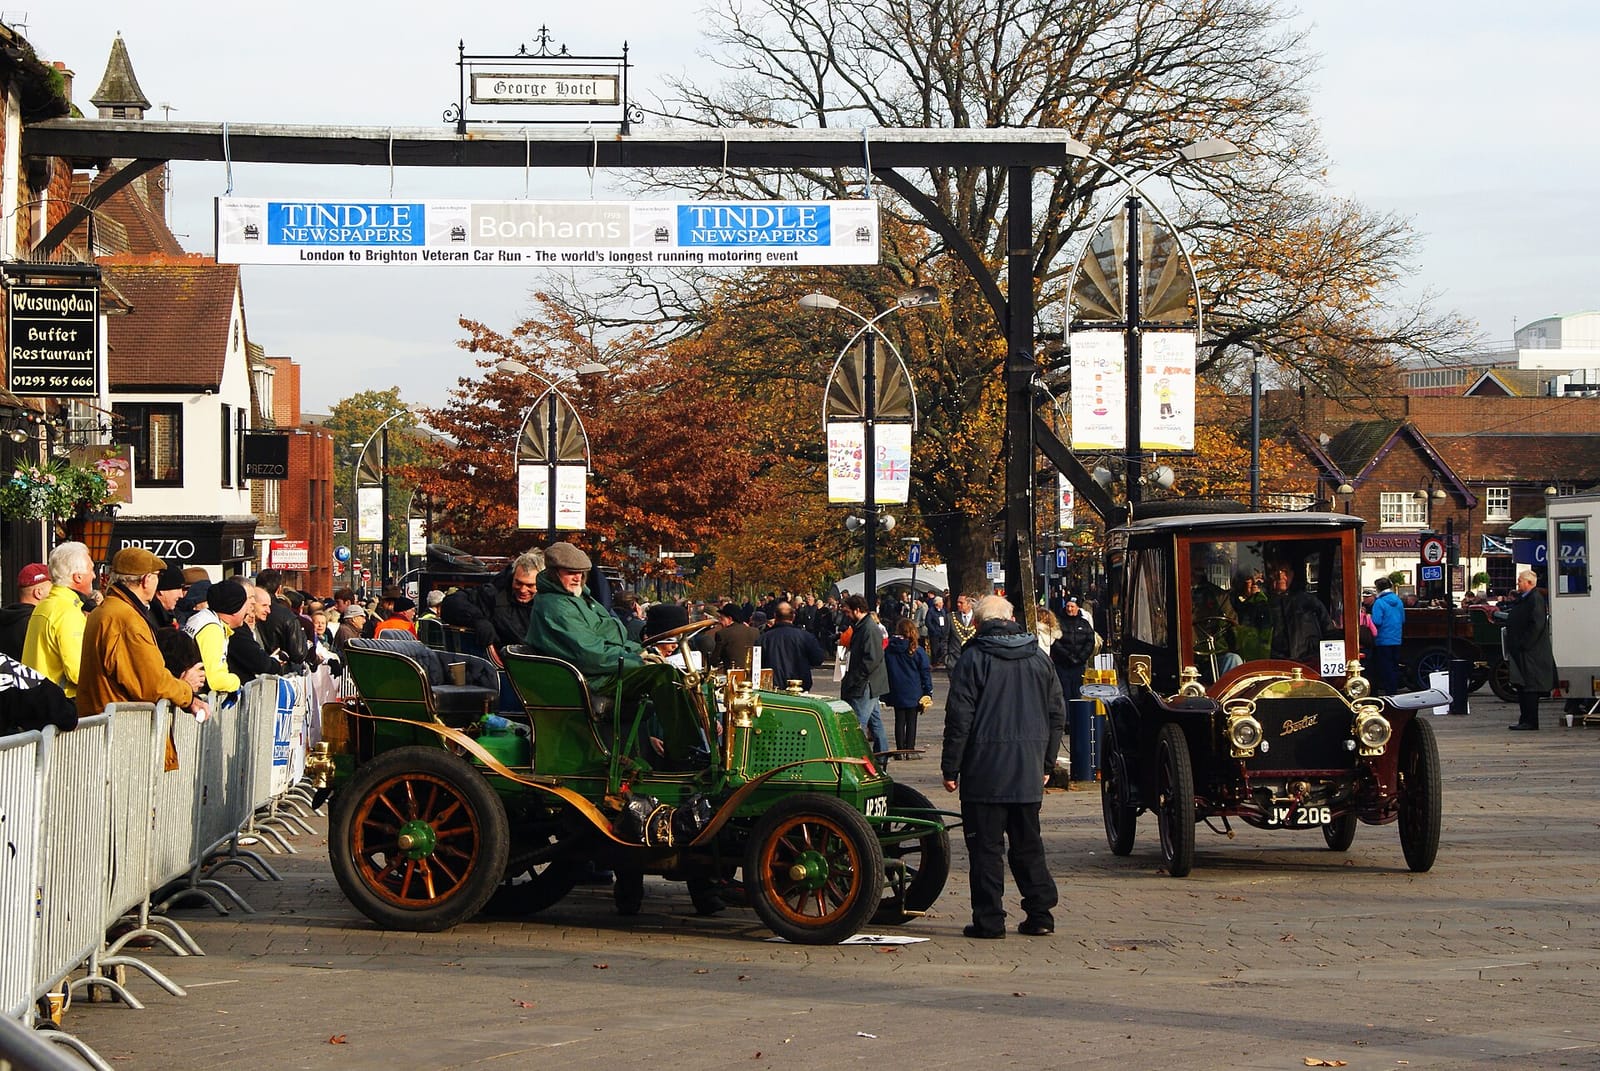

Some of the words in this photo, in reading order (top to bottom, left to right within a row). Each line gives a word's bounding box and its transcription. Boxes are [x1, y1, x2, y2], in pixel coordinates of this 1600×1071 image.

[494, 81, 547, 97] George
[556, 81, 597, 97] Hotel
[281, 204, 412, 227] TINDLE
[690, 206, 818, 229] TINDLE
[479, 215, 621, 239] Bonhams
[282, 228, 413, 242] NEWSPAPERS
[691, 229, 818, 243] NEWSPAPERS
[300, 249, 344, 261] London
[350, 249, 360, 261] to
[366, 249, 417, 264] Brighton
[423, 250, 469, 261] Veteran
[474, 250, 494, 261] Car
[497, 250, 521, 261] Run
[536, 250, 557, 261] The
[562, 250, 604, 262] world's
[609, 250, 653, 264] longest
[658, 250, 703, 264] running
[709, 250, 761, 264] motoring
[767, 250, 798, 261] event
[13, 292, 93, 316] Wusungdan
[28, 327, 78, 342] Buffet
[13, 346, 93, 361] Restaurant
[13, 375, 45, 386] 01293
[49, 376, 69, 387] 565
[71, 376, 93, 387] 666
[246, 464, 284, 475] PREZZO
[1323, 663, 1345, 675] 378
[1297, 807, 1331, 824] 206
